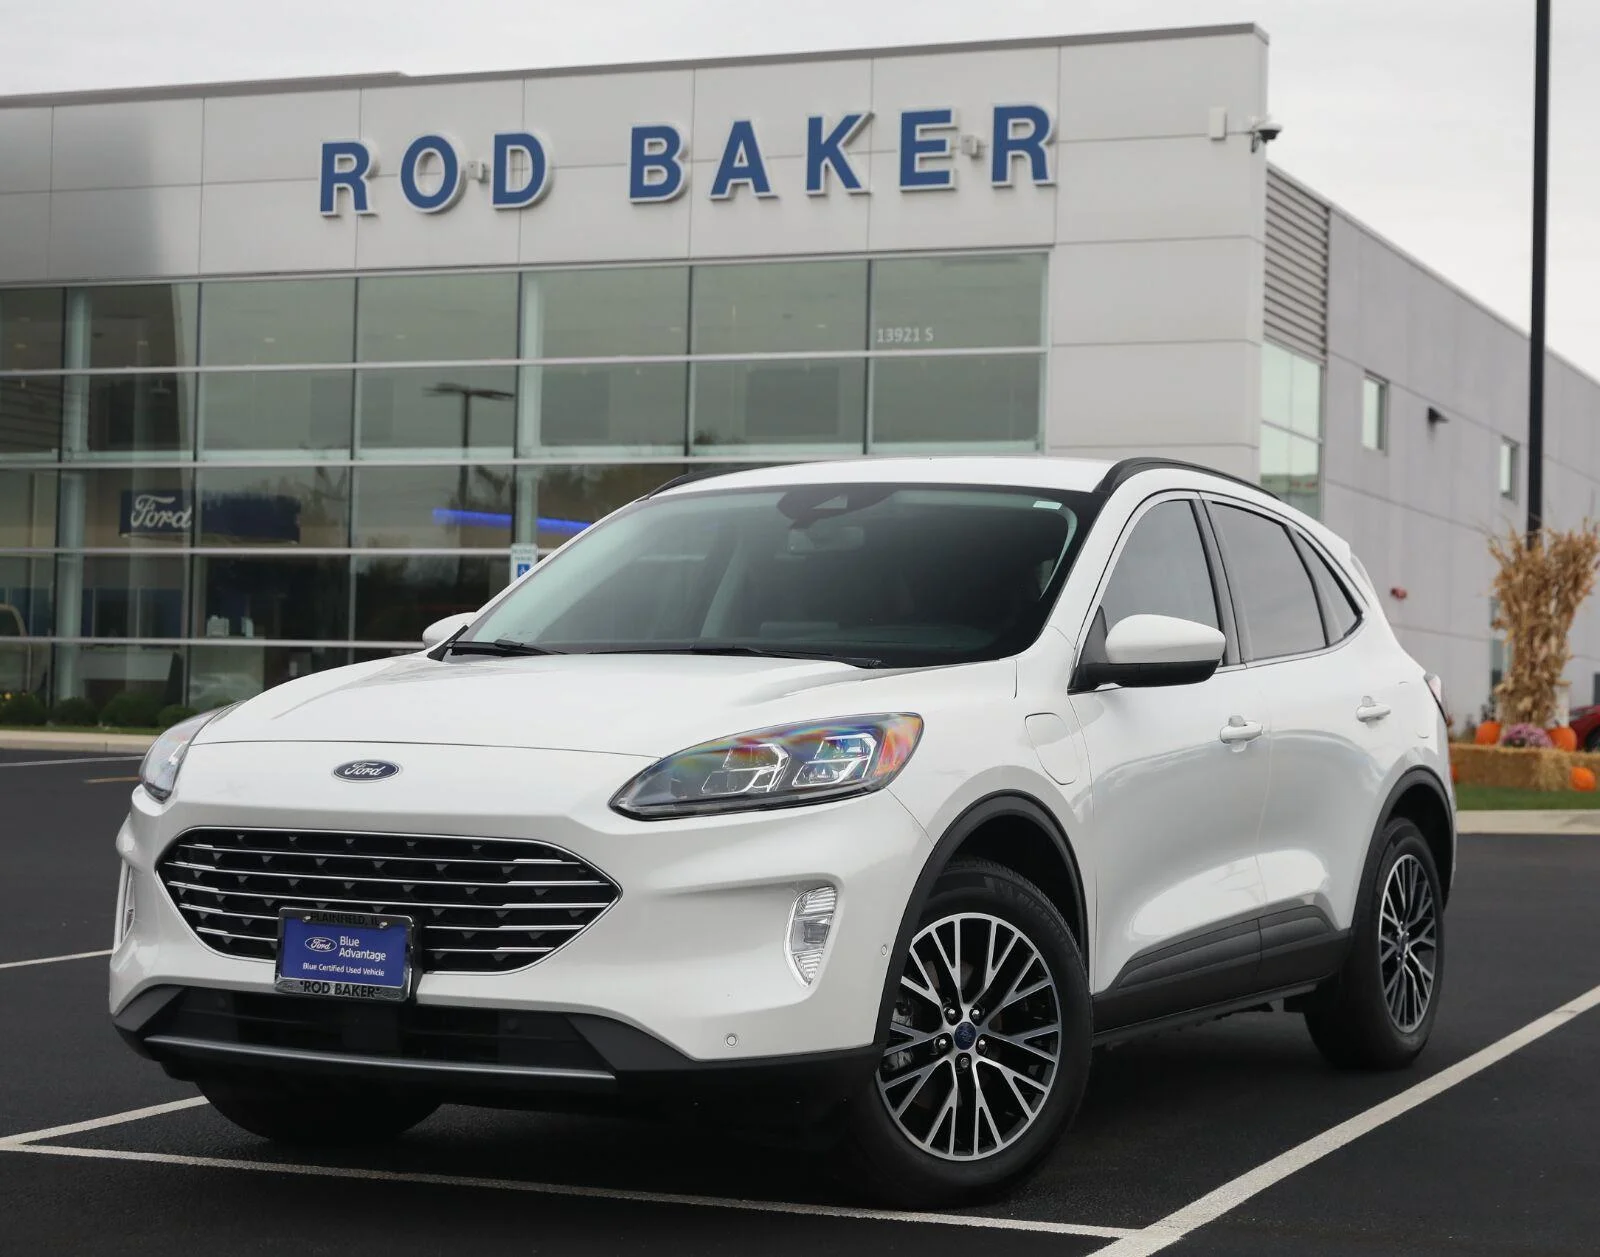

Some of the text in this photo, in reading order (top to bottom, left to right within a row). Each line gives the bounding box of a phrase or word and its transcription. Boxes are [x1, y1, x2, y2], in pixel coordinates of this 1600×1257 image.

[319, 104, 1056, 215] ROD BAKER
[877, 326, 934, 343] 13921 S
[130, 494, 192, 528] Ford
[344, 761, 386, 776] Ford
[310, 938, 331, 950] Ford
[340, 935, 360, 947] Blue
[338, 947, 387, 962] Advantage
[302, 962, 385, 976] Blue Certified Used Vehicle
